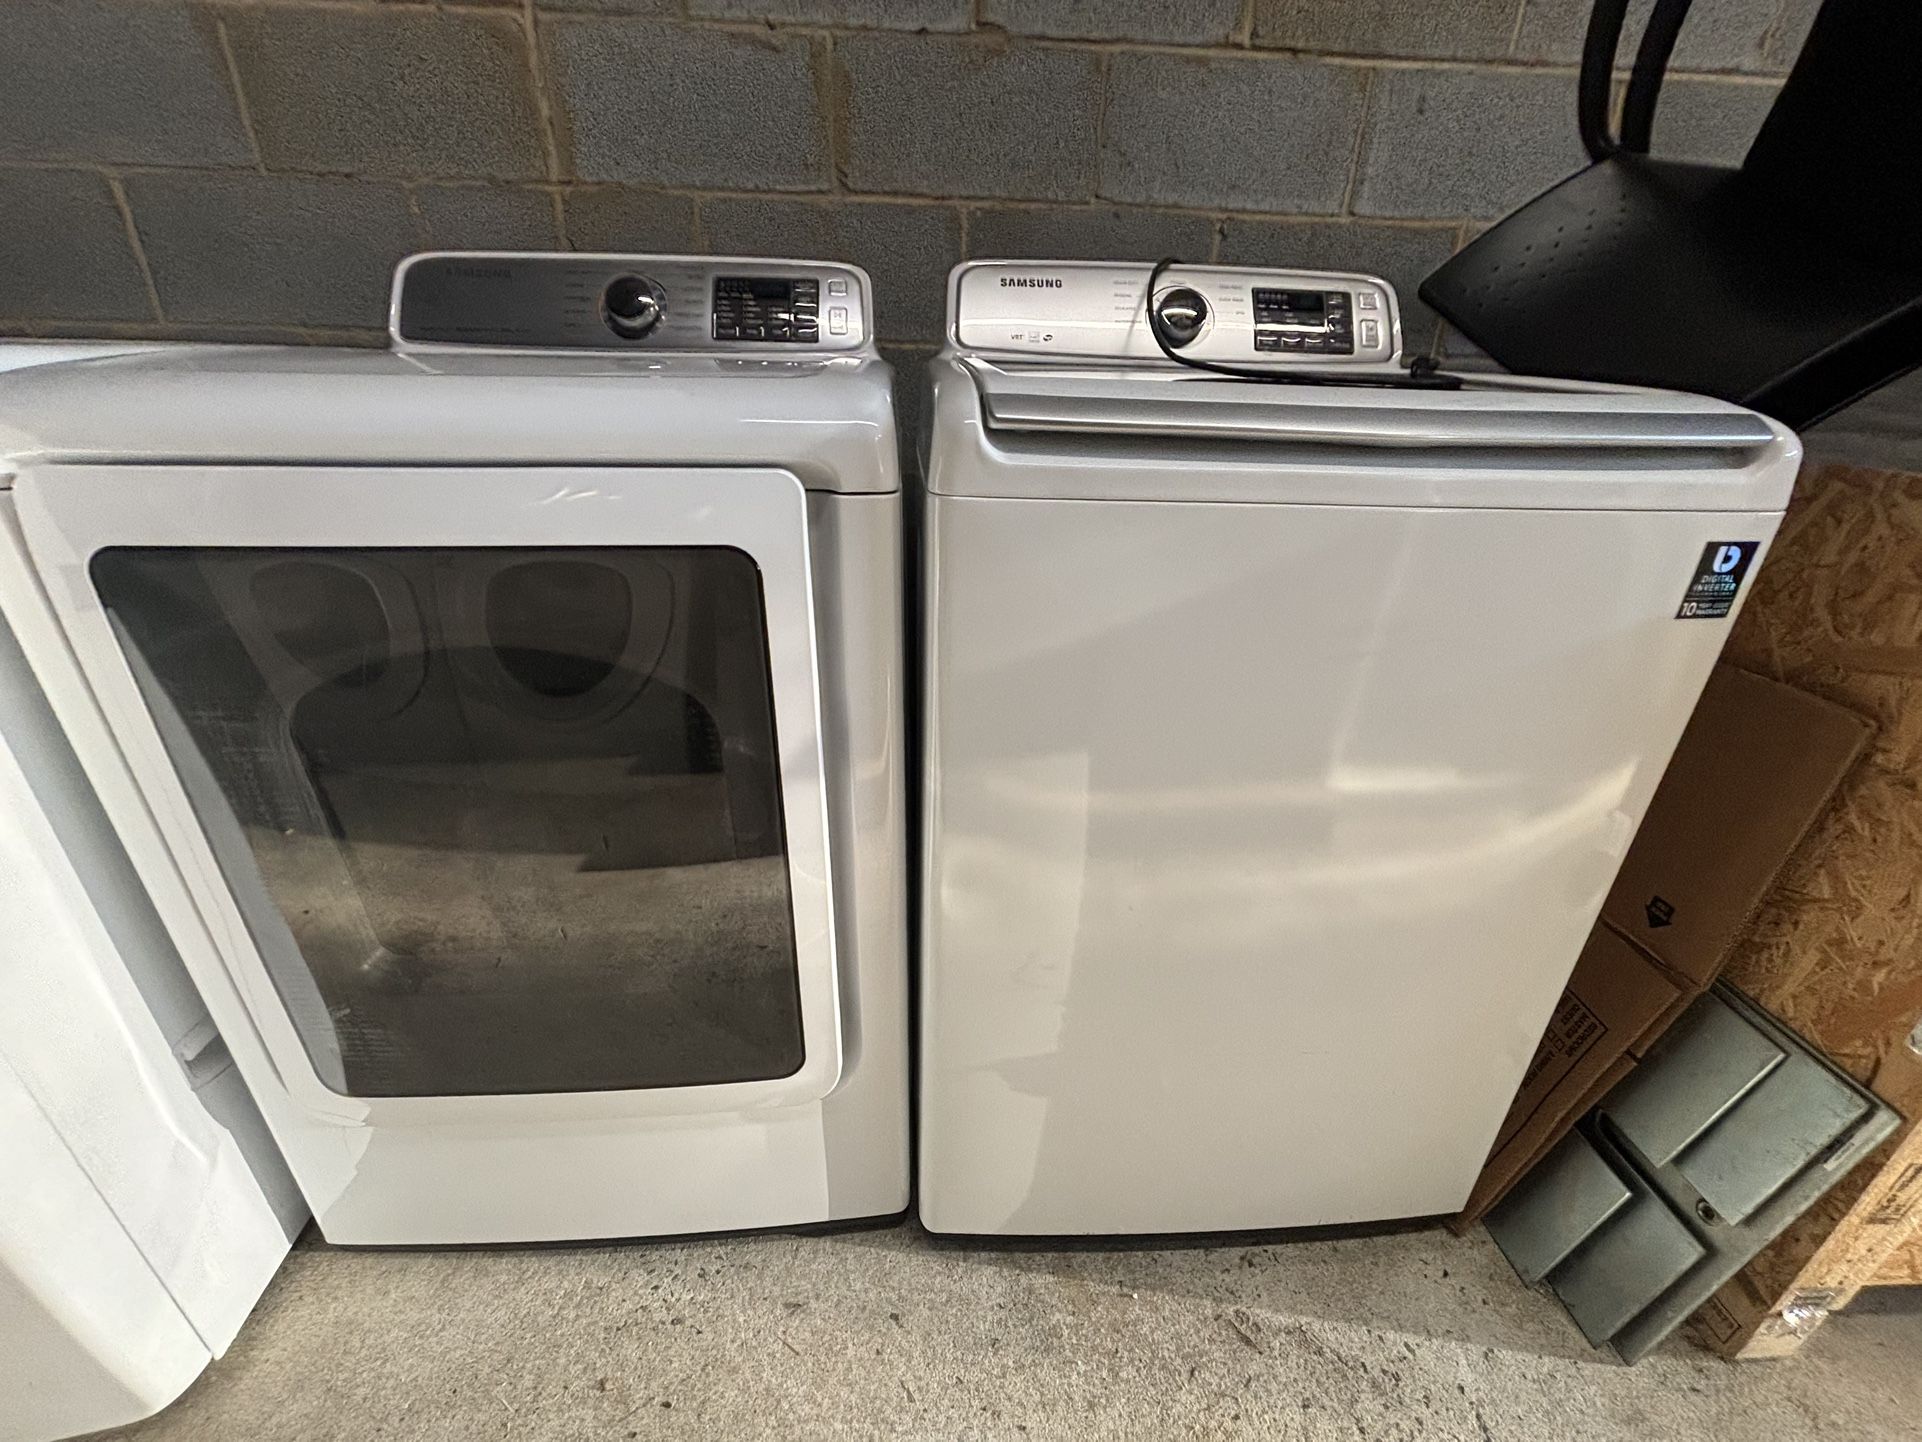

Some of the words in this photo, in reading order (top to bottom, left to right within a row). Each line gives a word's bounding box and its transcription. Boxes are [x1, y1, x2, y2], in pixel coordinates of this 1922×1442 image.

[1000, 277, 1062, 288] SAMSUNG
[1701, 575, 1734, 583] DIGITAL
[1692, 583, 1736, 592] INVERTER
[1681, 602, 1697, 617] 10
